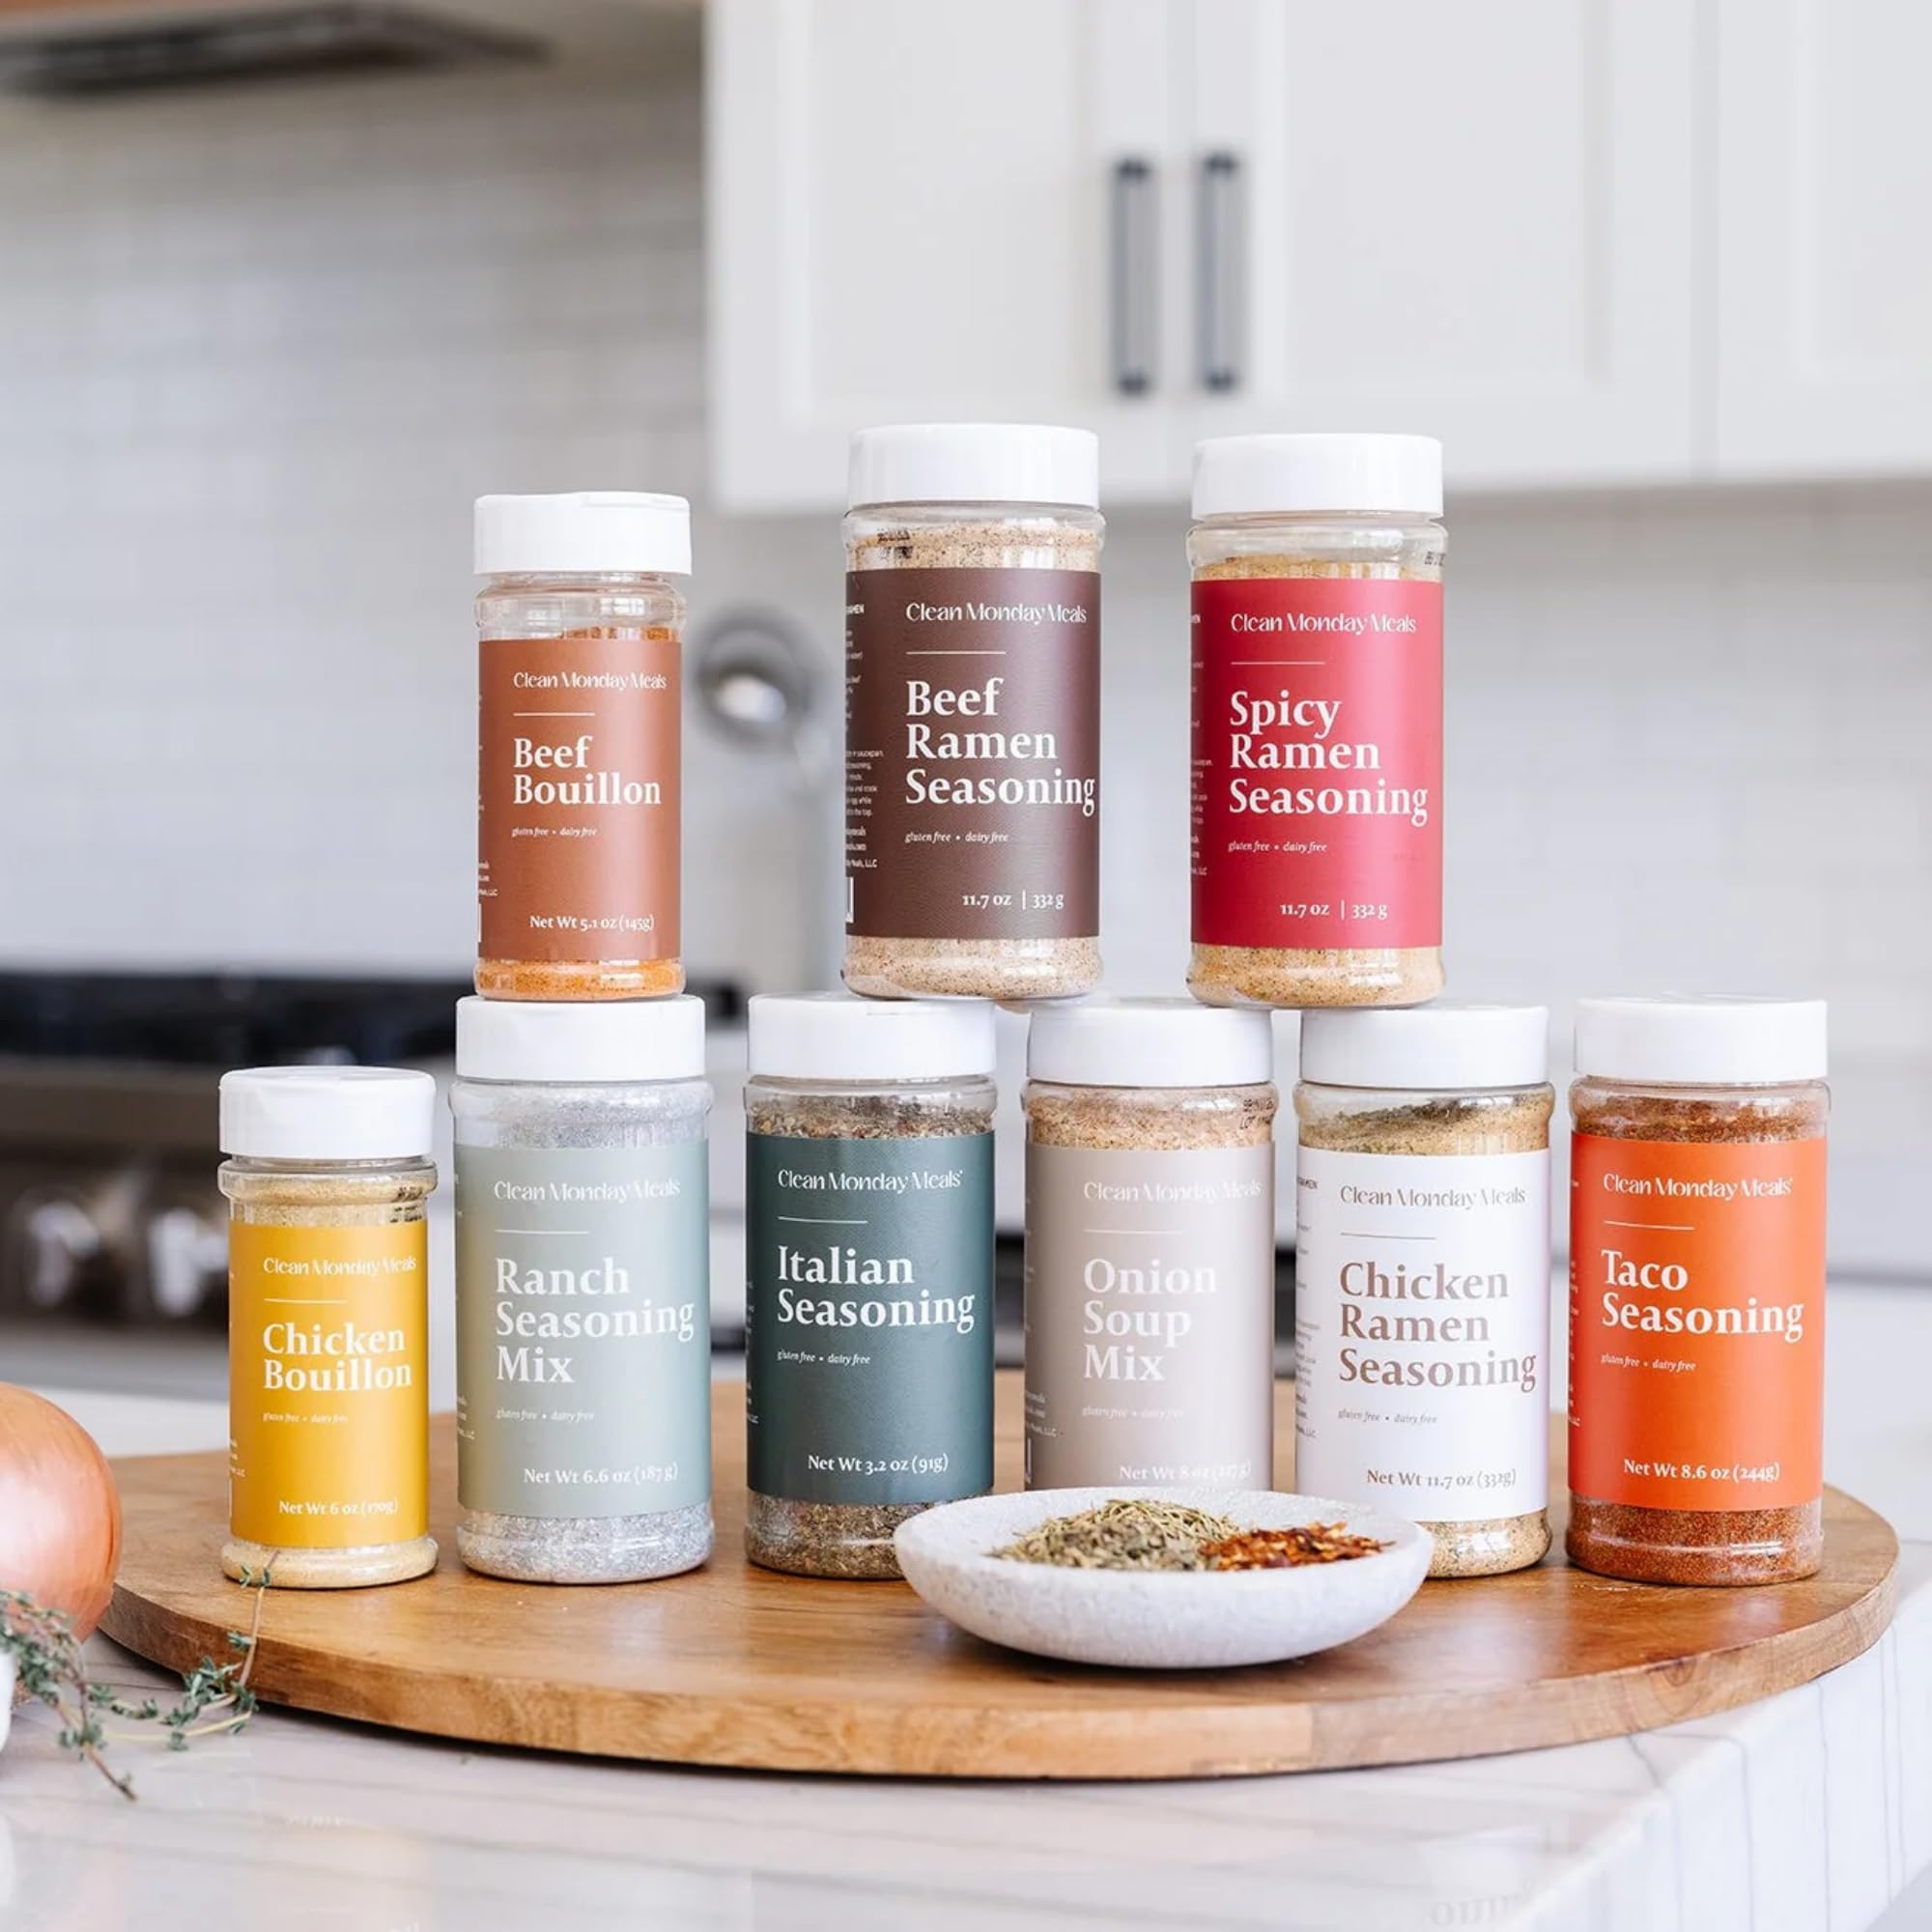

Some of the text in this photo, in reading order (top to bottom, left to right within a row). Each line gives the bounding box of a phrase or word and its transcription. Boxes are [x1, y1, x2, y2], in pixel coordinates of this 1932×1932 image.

[905, 602, 1087, 625] Clean Monday Meals
[1231, 612, 1417, 636] Clean Monday Meals
[513, 671, 667, 692] Clean Monday Meals
[906, 676, 1005, 717] Beef
[1229, 689, 1342, 739] Spicy
[513, 735, 593, 769] Beef
[906, 724, 1057, 760] Ramen
[1229, 733, 1380, 771] Ramen
[513, 774, 662, 806] Bouillon
[905, 768, 1095, 816] Seasoning
[1229, 778, 1429, 827] Seasoning
[904, 831, 1009, 844] gluten free dairy free
[1228, 839, 1328, 854] gluten free dairy free
[962, 895, 989, 909] 11.7
[992, 895, 1012, 906] oz
[1032, 895, 1054, 909] 332
[1280, 904, 1307, 919] 11.7
[1310, 904, 1330, 915] oz
[1351, 904, 1376, 920] 332
[529, 913, 654, 931] Net Wt 5.1 oz (145g)
[494, 1178, 681, 1204] Clean Monday Meals
[778, 1169, 825, 1190] Clean
[828, 1171, 908, 1194] Monday
[1084, 1179, 1262, 1204] Clean Monday Meals
[1340, 1184, 1526, 1210] Clean Monday Meals
[1603, 1173, 1652, 1195] Clean
[1655, 1177, 1738, 1201] Monday
[263, 1256, 416, 1278] Clean Monday Meals
[495, 1256, 630, 1295] Ranch
[778, 1244, 915, 1285] Italian
[1083, 1257, 1217, 1294] Onion
[1339, 1261, 1510, 1300] Chicken
[1600, 1248, 1689, 1292] Taco
[496, 1298, 695, 1342] Seasoning
[778, 1288, 976, 1334] Seasoning
[1083, 1299, 1191, 1348] Soup
[1339, 1304, 1490, 1343] Ramen
[1601, 1292, 1804, 1343] Seasoning
[262, 1321, 406, 1356] Chicken
[496, 1345, 576, 1383] Mix
[798, 1350, 816, 1364] free
[827, 1352, 851, 1366] dairy
[850, 1352, 871, 1366] free
[1083, 1344, 1166, 1381] Mix
[1339, 1348, 1537, 1393] Seasoning
[263, 1358, 412, 1392] Bouillon
[524, 1468, 550, 1484] Net
[554, 1468, 580, 1485] Wt
[582, 1468, 611, 1485] 6.6
[612, 1471, 631, 1483] oz
[808, 1453, 949, 1475] Net Wt 3.2 oz (91g)
[1120, 1464, 1148, 1480] Net
[1151, 1464, 1176, 1480] Wt
[1367, 1468, 1518, 1490] Net Wt 11.7 oz (332g)
[1623, 1459, 1780, 1483] Net Wt 8.6 oz (244g)
[279, 1500, 302, 1514] Net
[305, 1501, 326, 1515] Wt
[329, 1501, 339, 1515] 6
[342, 1504, 357, 1515] oz
